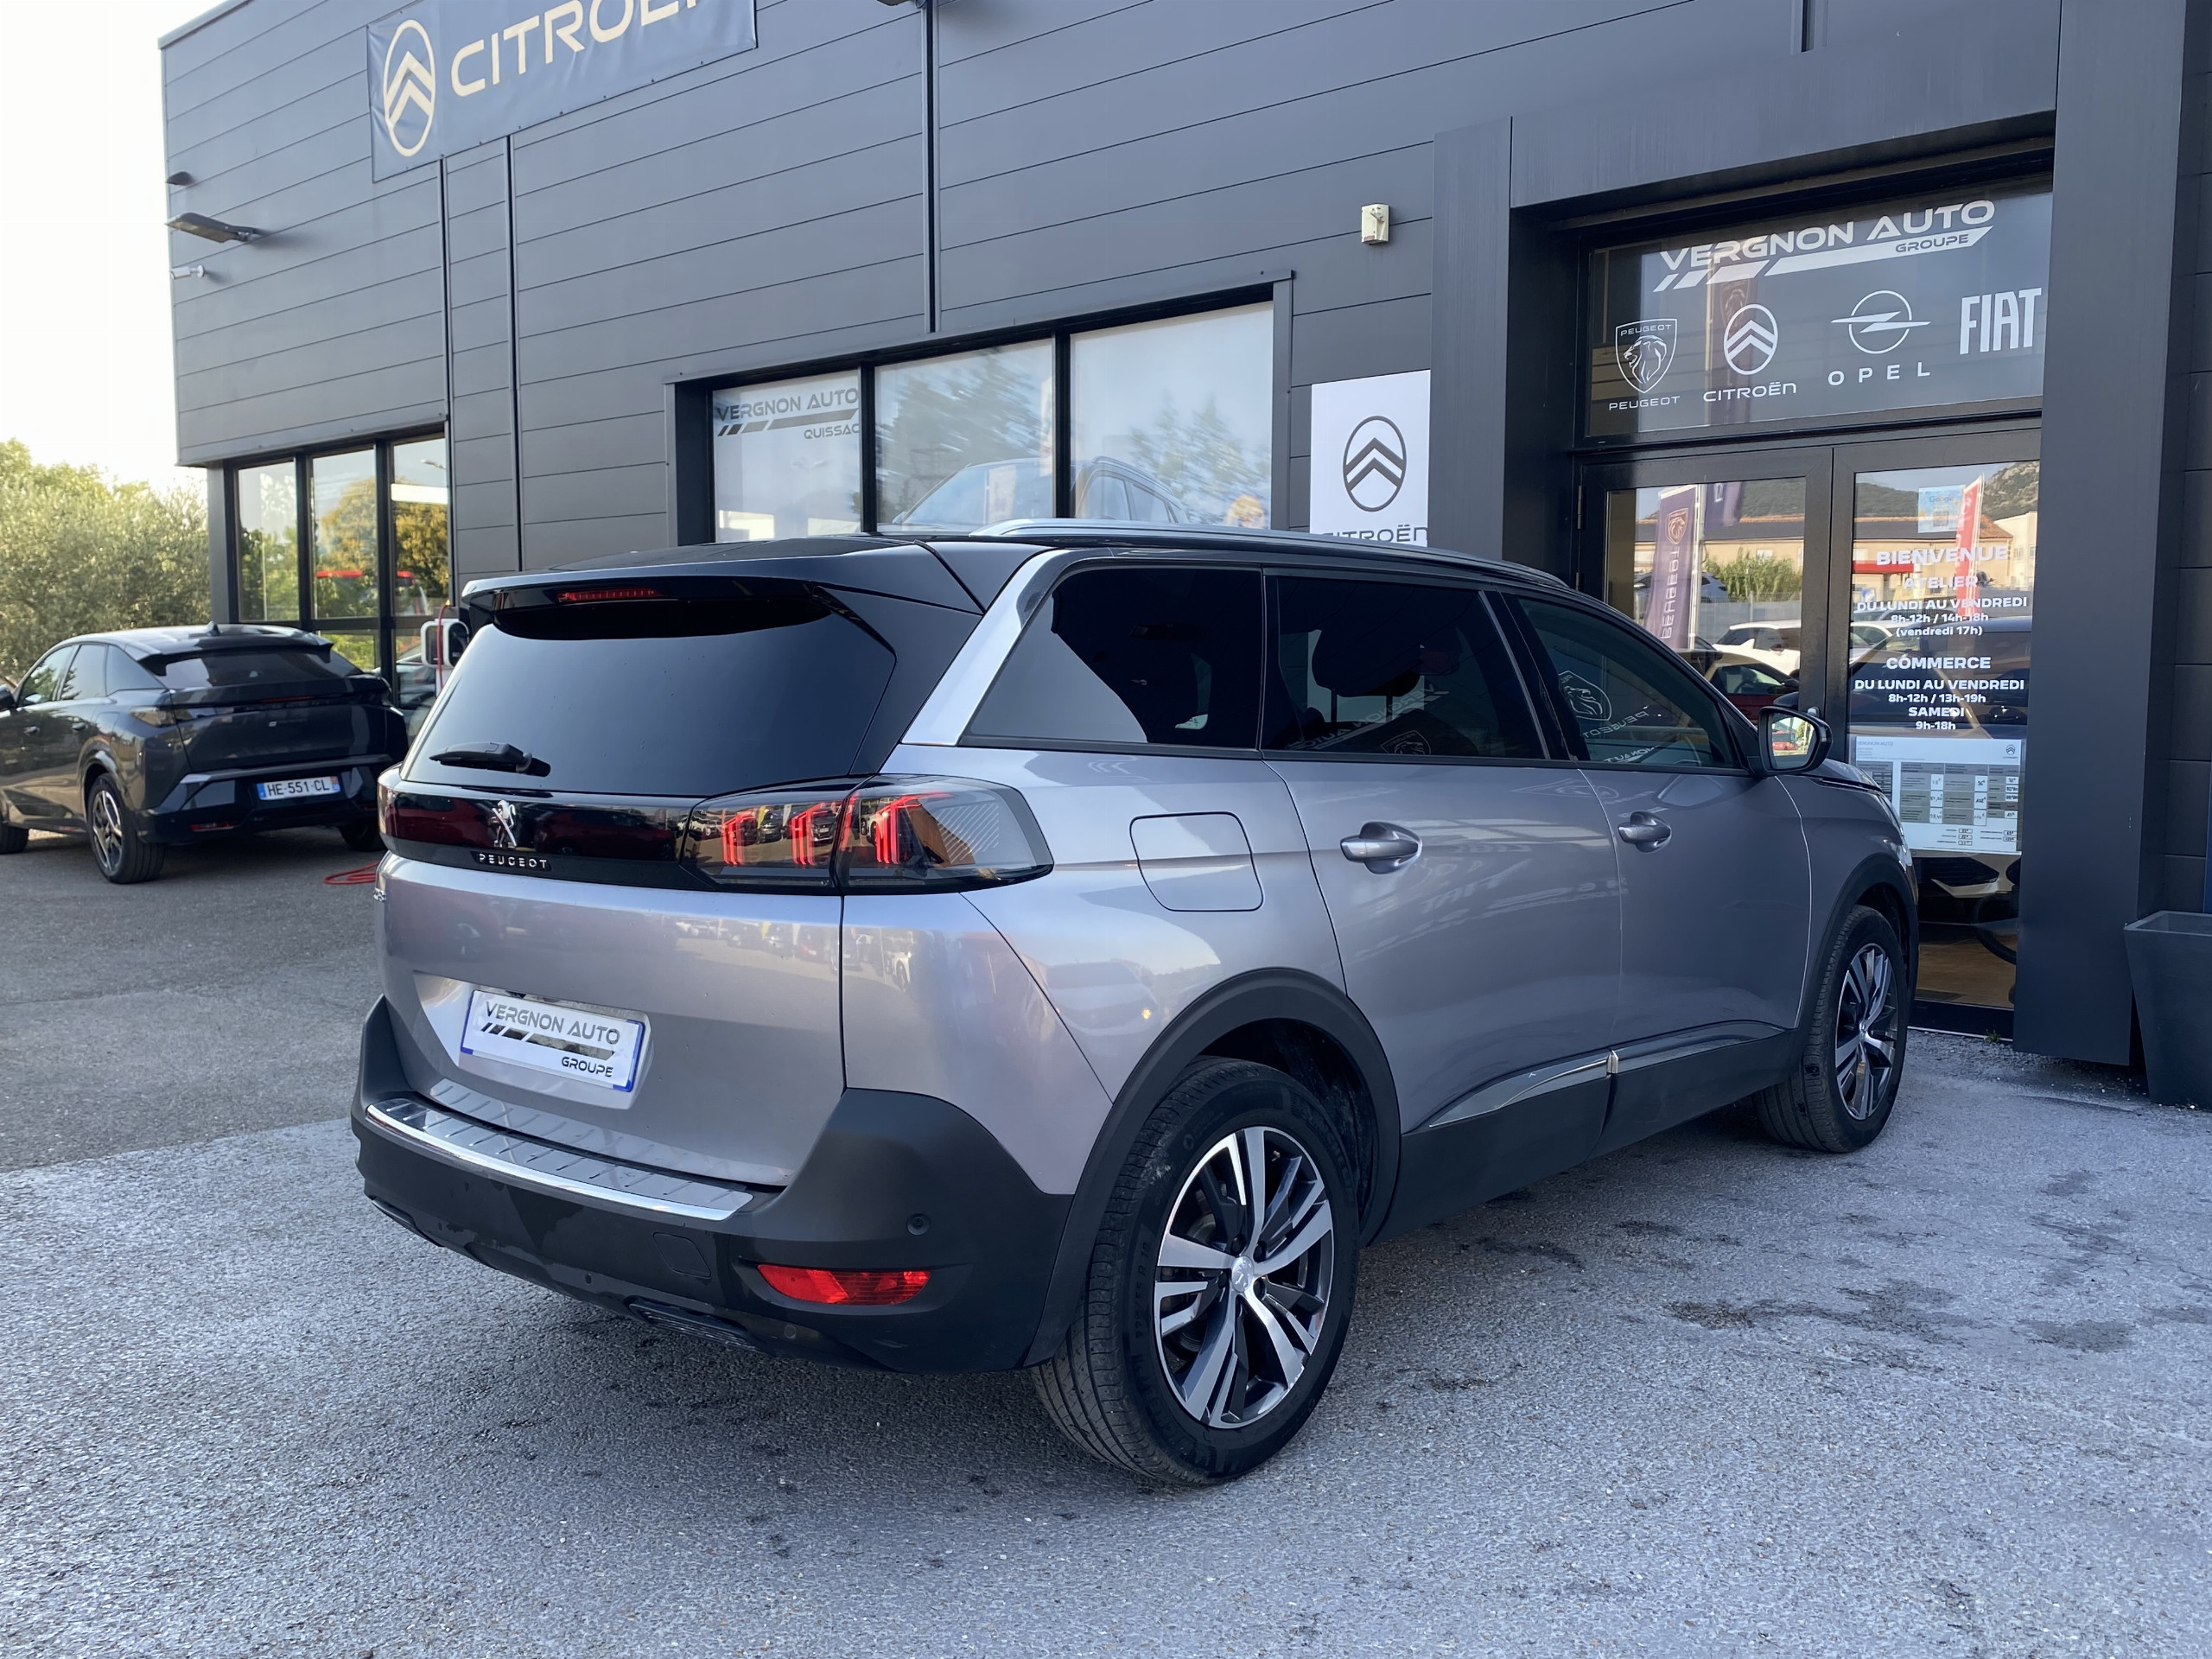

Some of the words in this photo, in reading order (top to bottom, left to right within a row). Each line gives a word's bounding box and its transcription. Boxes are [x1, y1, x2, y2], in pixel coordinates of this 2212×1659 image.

[451, 0, 697, 97] CITRO
[1660, 220, 1853, 270] VERGNON
[1867, 200, 1995, 240] AUTO
[1895, 233, 1969, 253] GROUPE
[1959, 288, 2043, 355] FIAT
[1620, 324, 1672, 336] PEUGEOT
[1827, 361, 1931, 386] OPEL
[716, 396, 801, 422] VERGNON
[806, 388, 859, 410] AUTO
[1608, 396, 1681, 410] PEUGEOT
[804, 423, 859, 440] QUISSAC
[1877, 545, 2009, 566] BIENVENUE
[1904, 575, 1979, 589] ATELIER
[1858, 601, 1879, 612] DU
[1880, 600, 1923, 611] LUNDI
[1925, 599, 1947, 610] AU
[1950, 596, 2028, 609] VENDREDI
[1891, 613, 1931, 624] 8h-12h
[1942, 613, 1989, 623] 14h-18h
[1896, 626, 1954, 638] (vendredi
[1956, 626, 1983, 636] 17h)
[1886, 657, 1992, 670] COMMERCE
[1854, 680, 1875, 690] DU
[1878, 680, 1920, 690] LUNDI
[1923, 680, 1944, 690] AU
[1948, 679, 2024, 690] VENDREDI
[1888, 694, 1928, 703] 8h-12h
[1930, 694, 1936, 703] /
[1939, 693, 1986, 702] 13h-19h
[1908, 707, 1965, 717] SAMEDI
[1916, 721, 1956, 730] 9h-18h
[479, 853, 548, 869] PEUGEOT
[486, 1001, 564, 1033] VERGNON
[566, 1020, 620, 1045] AUTO
[562, 1057, 613, 1077] GROUPE
